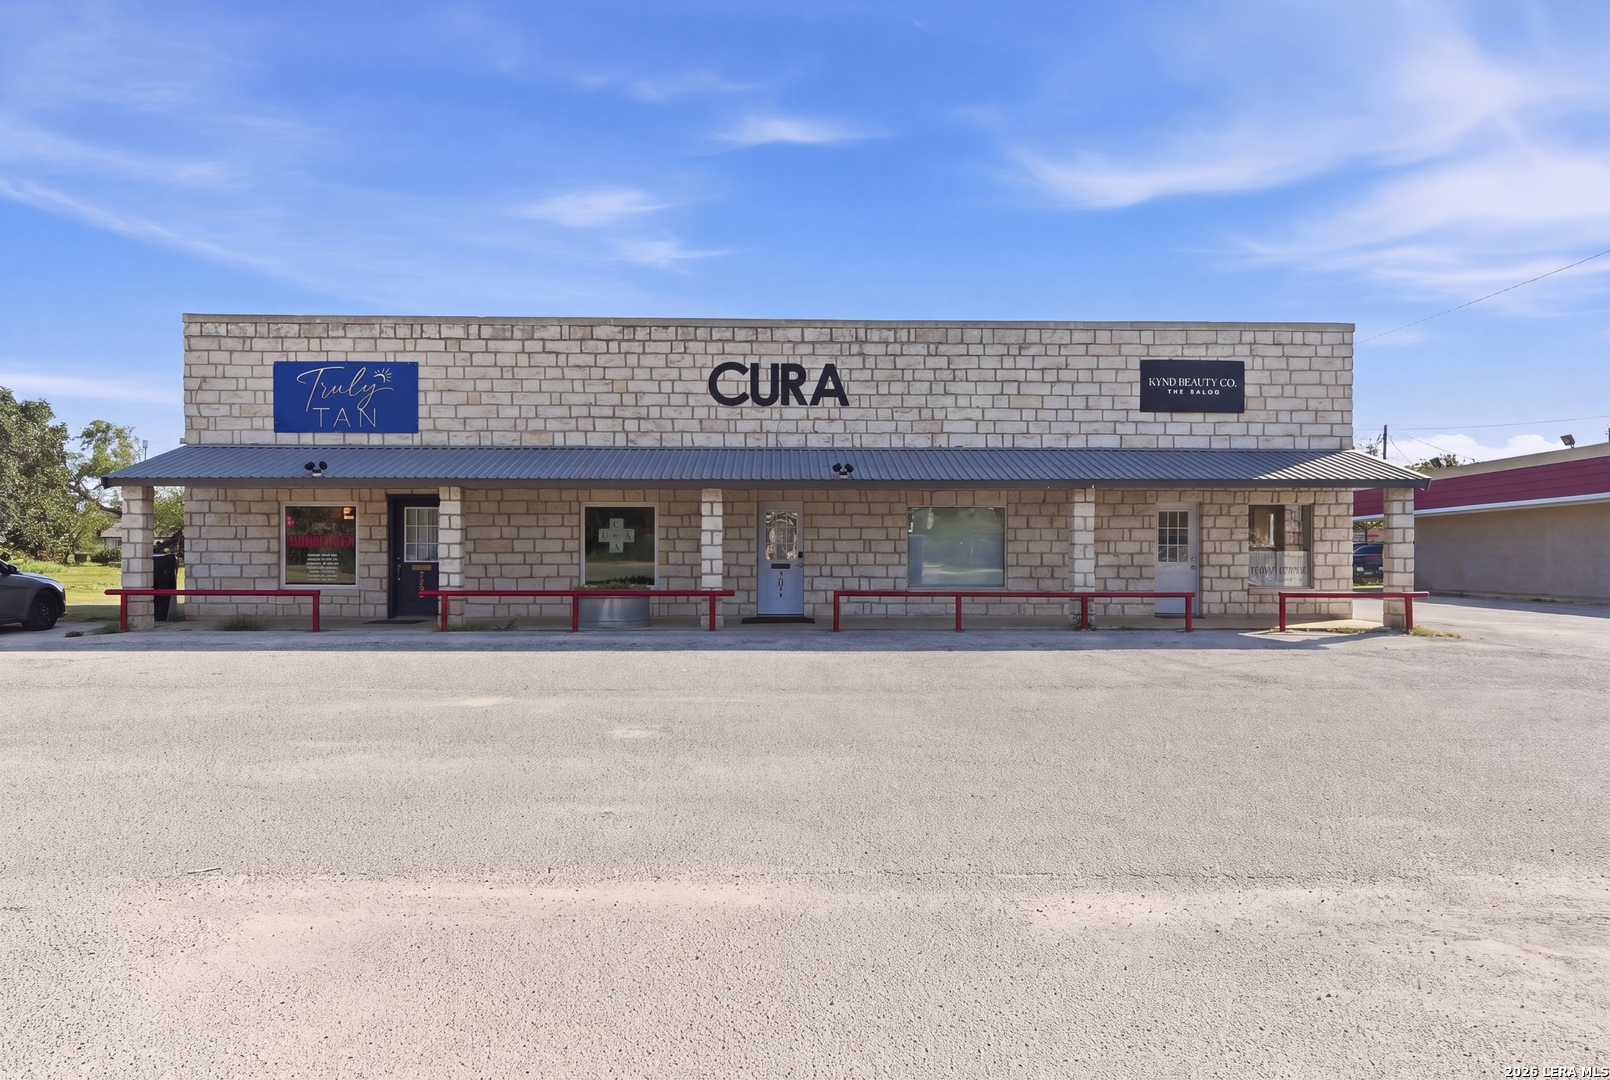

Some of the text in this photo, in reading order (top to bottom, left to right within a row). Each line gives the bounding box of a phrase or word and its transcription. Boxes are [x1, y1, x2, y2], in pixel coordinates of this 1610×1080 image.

[296, 366, 394, 412] Truly
[708, 361, 850, 407] CURA
[1148, 377, 1238, 388] KYND BEAUTY CO.
[312, 407, 376, 428] TAN
